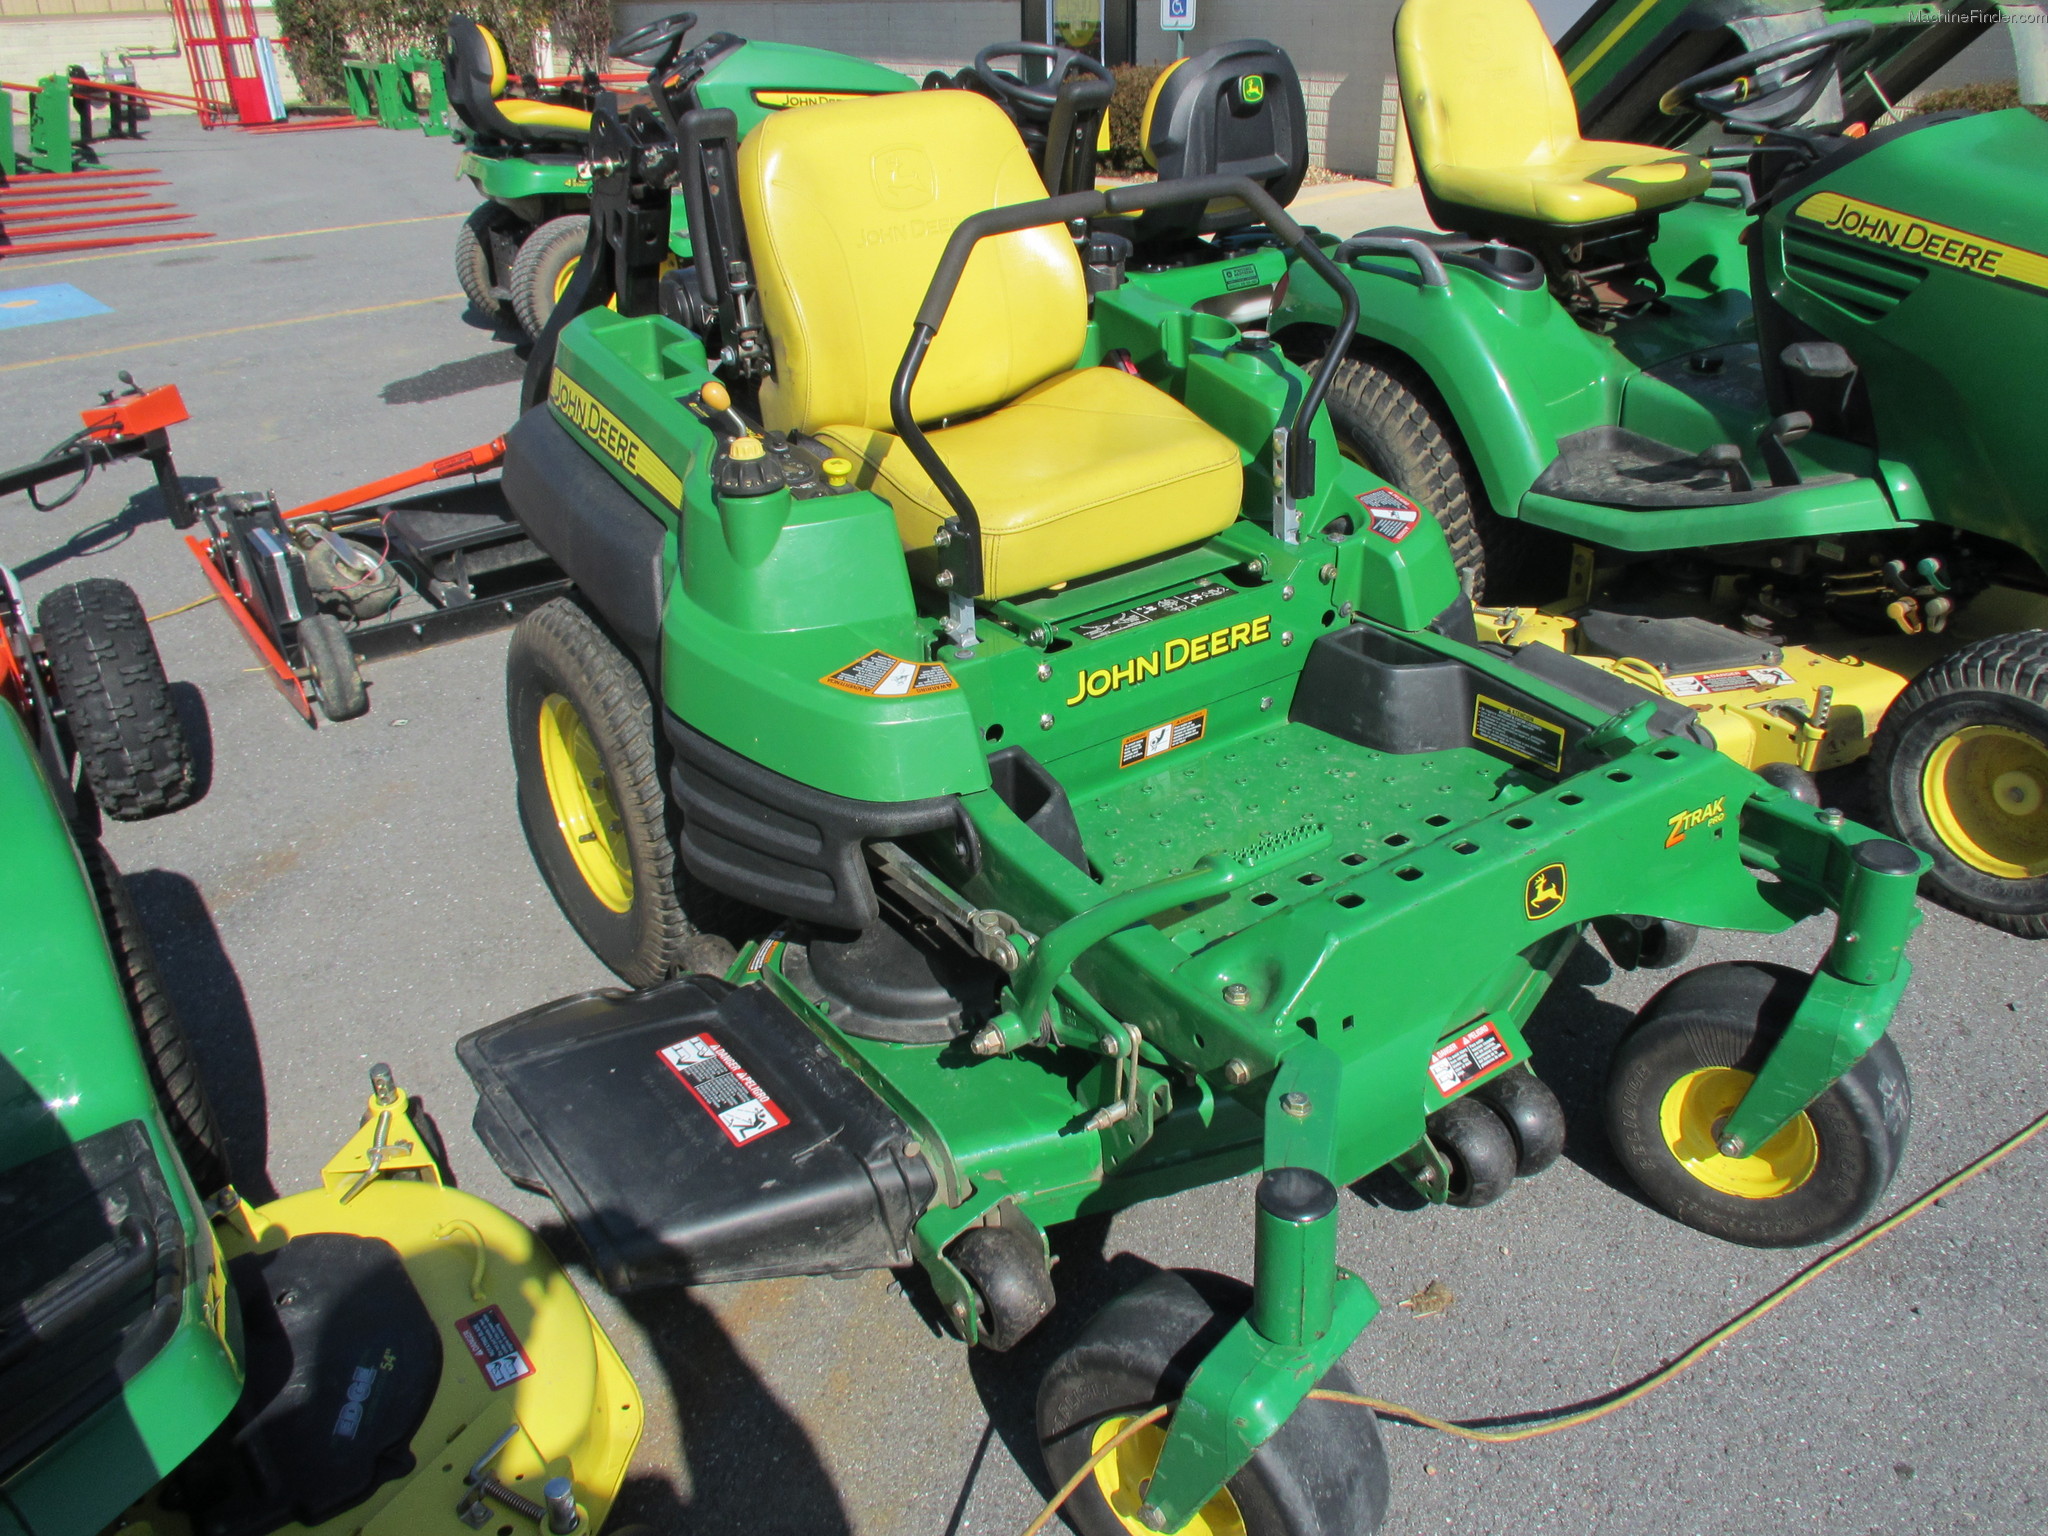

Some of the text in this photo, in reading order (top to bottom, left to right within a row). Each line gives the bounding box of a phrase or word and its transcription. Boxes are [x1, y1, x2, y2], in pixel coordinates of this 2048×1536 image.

[782, 95, 817, 107] JOHN
[858, 225, 908, 248] JOHN
[1826, 203, 2004, 275] JOHN DEERE
[551, 374, 640, 474] JOHN DEERE
[1066, 614, 1271, 706] JOHN DEERE
[1707, 812, 1726, 828] PRO
[715, 1048, 742, 1072] DANGER
[742, 1076, 771, 1103] PELIGRO
[333, 1366, 377, 1440] EDGE
